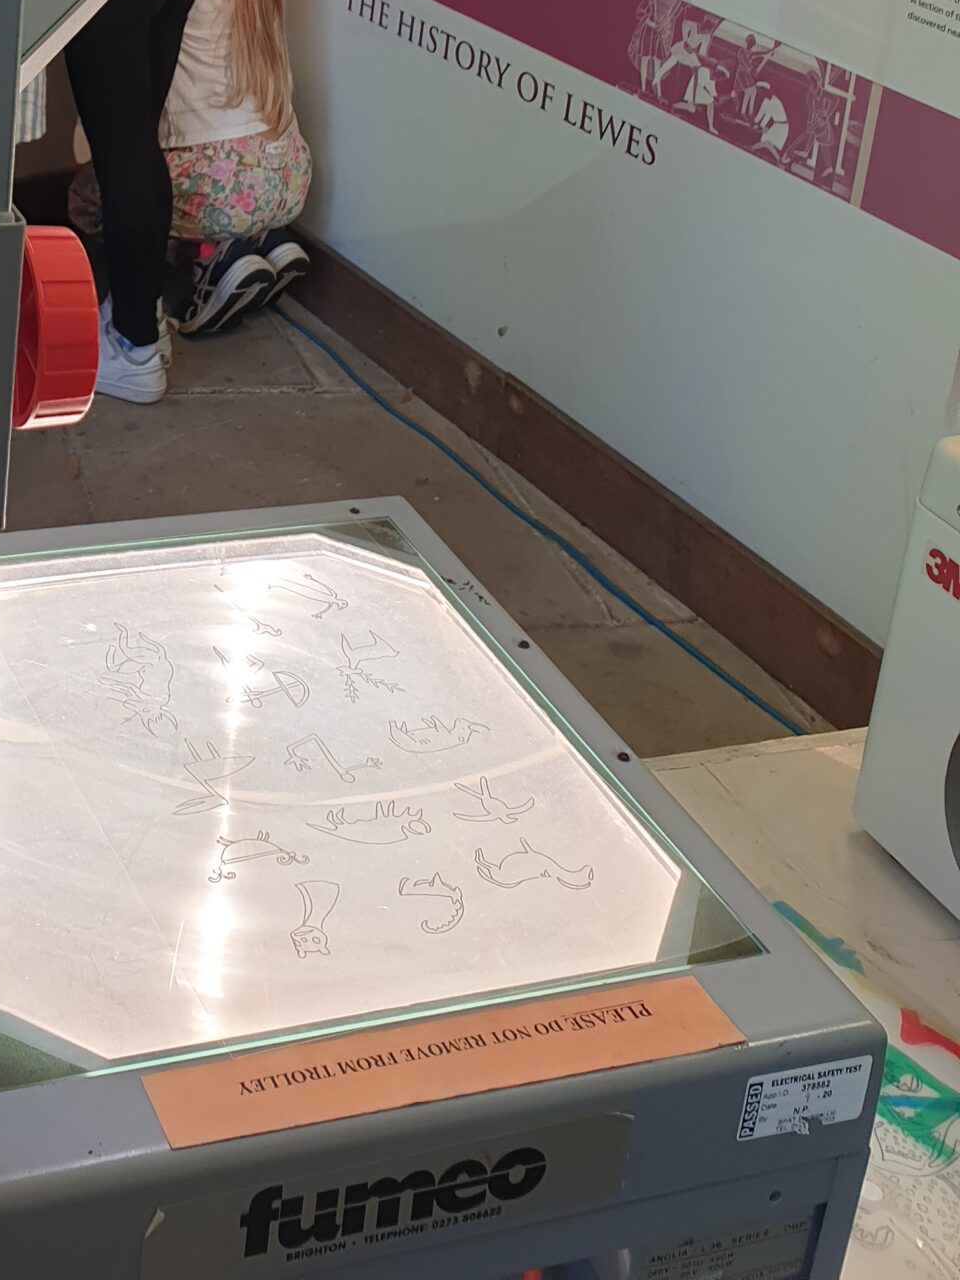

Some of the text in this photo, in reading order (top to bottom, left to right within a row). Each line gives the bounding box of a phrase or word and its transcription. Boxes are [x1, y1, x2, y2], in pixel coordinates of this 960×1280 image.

[918, 0, 944, 15] section
[945, 10, 955, 18] of
[907, 11, 960, 40] discovered nea
[396, 9, 512, 90] HISTORY
[516, 71, 556, 113] OF
[562, 91, 659, 166] LEWES
[239, 1000, 652, 1096] PLEASE DO NOT REMOVE FROM TROLLEY
[771, 1064, 862, 1087] ELECTRICAL SAFETY TEST
[823, 1090, 833, 1100] 20
[741, 1083, 763, 1137] PASSED
[240, 1147, 547, 1258] fumeo
[286, 1241, 346, 1262] BRIGHTON
